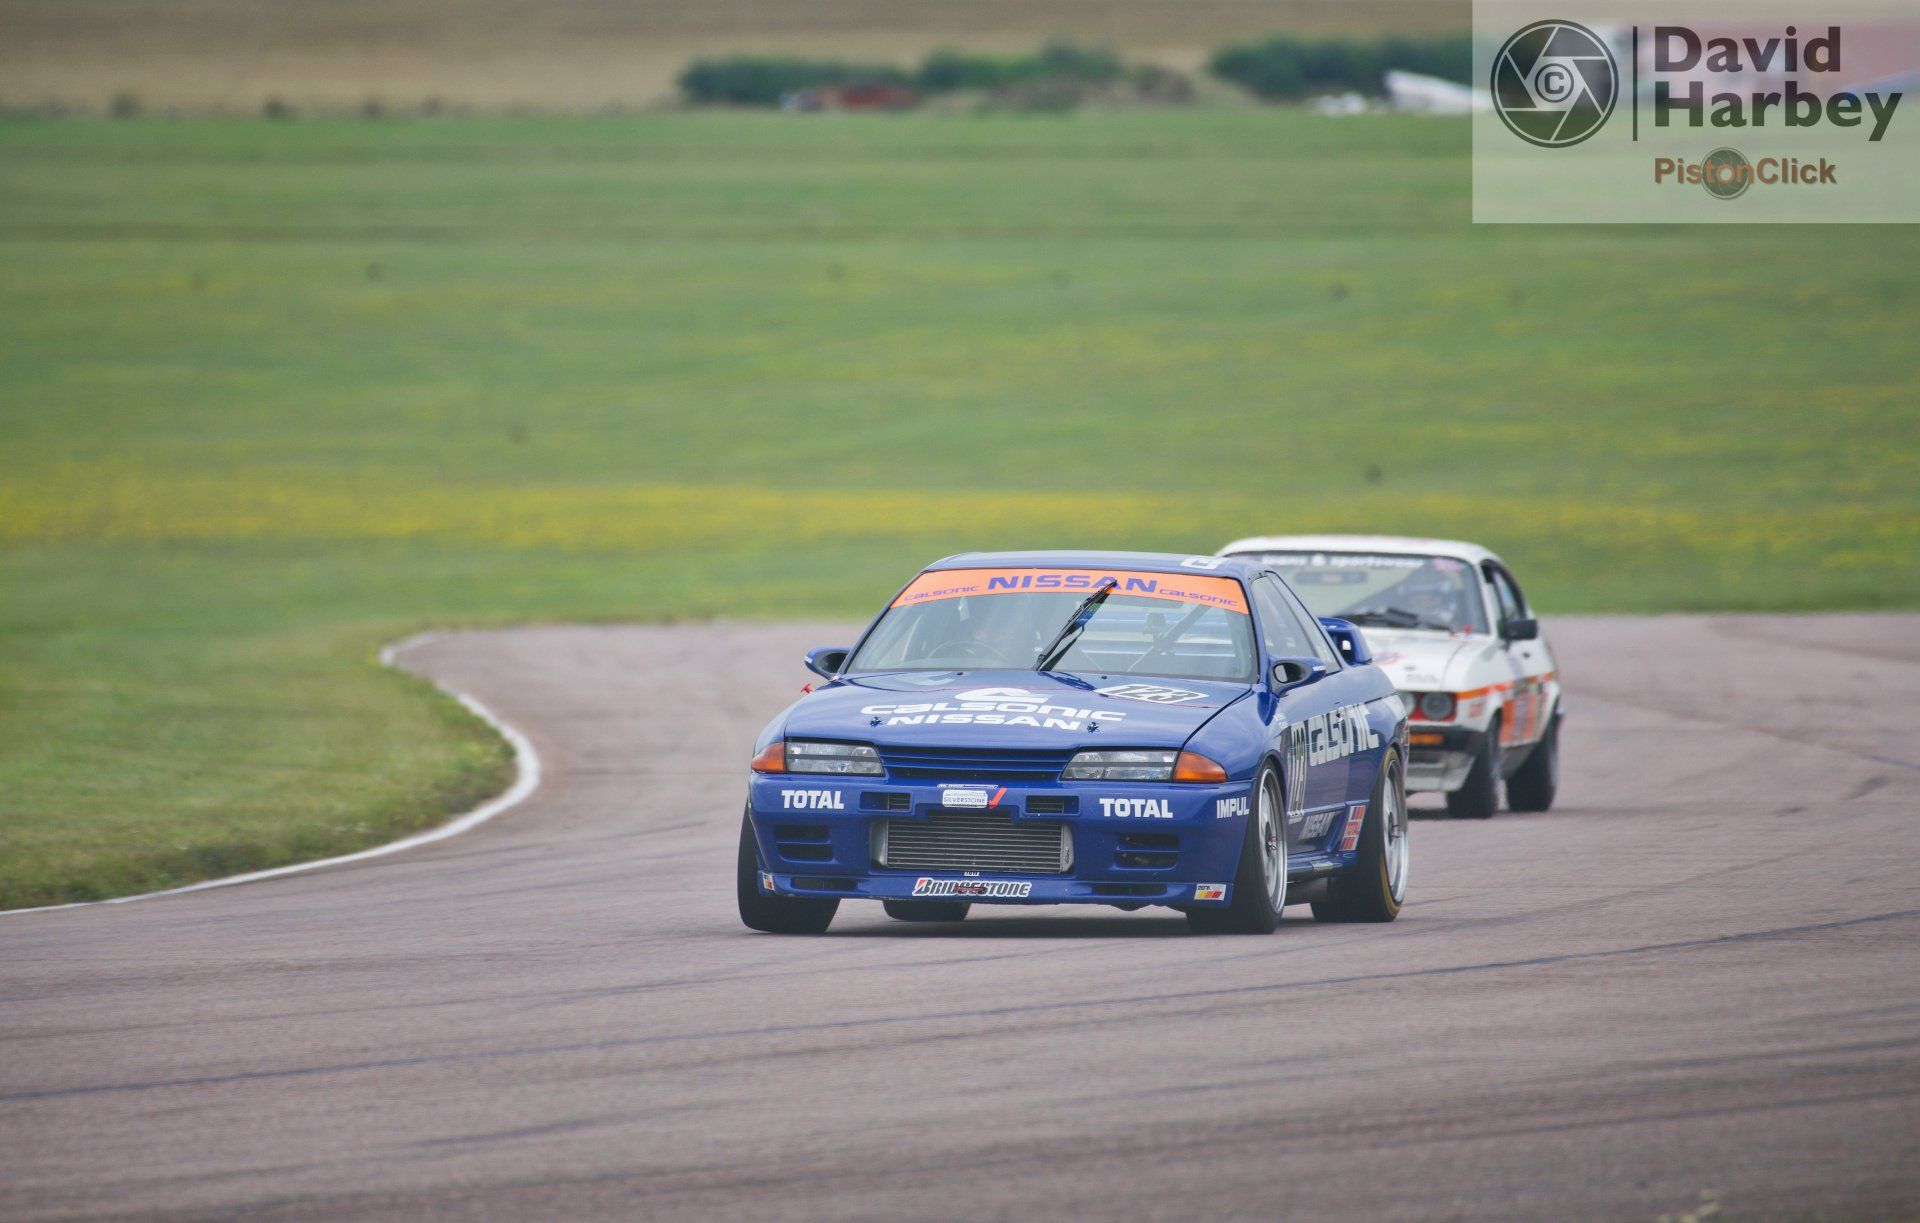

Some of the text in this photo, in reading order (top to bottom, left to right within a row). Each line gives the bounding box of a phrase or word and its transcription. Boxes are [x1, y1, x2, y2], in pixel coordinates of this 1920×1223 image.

[987, 574, 1158, 593] NISSAN
[886, 713, 1081, 731] NISSAN
[781, 789, 844, 809] TOTAL
[943, 796, 986, 804] SILVERSTONE
[1099, 798, 1173, 818] TOTAL
[1216, 796, 1250, 819] IMPUL
